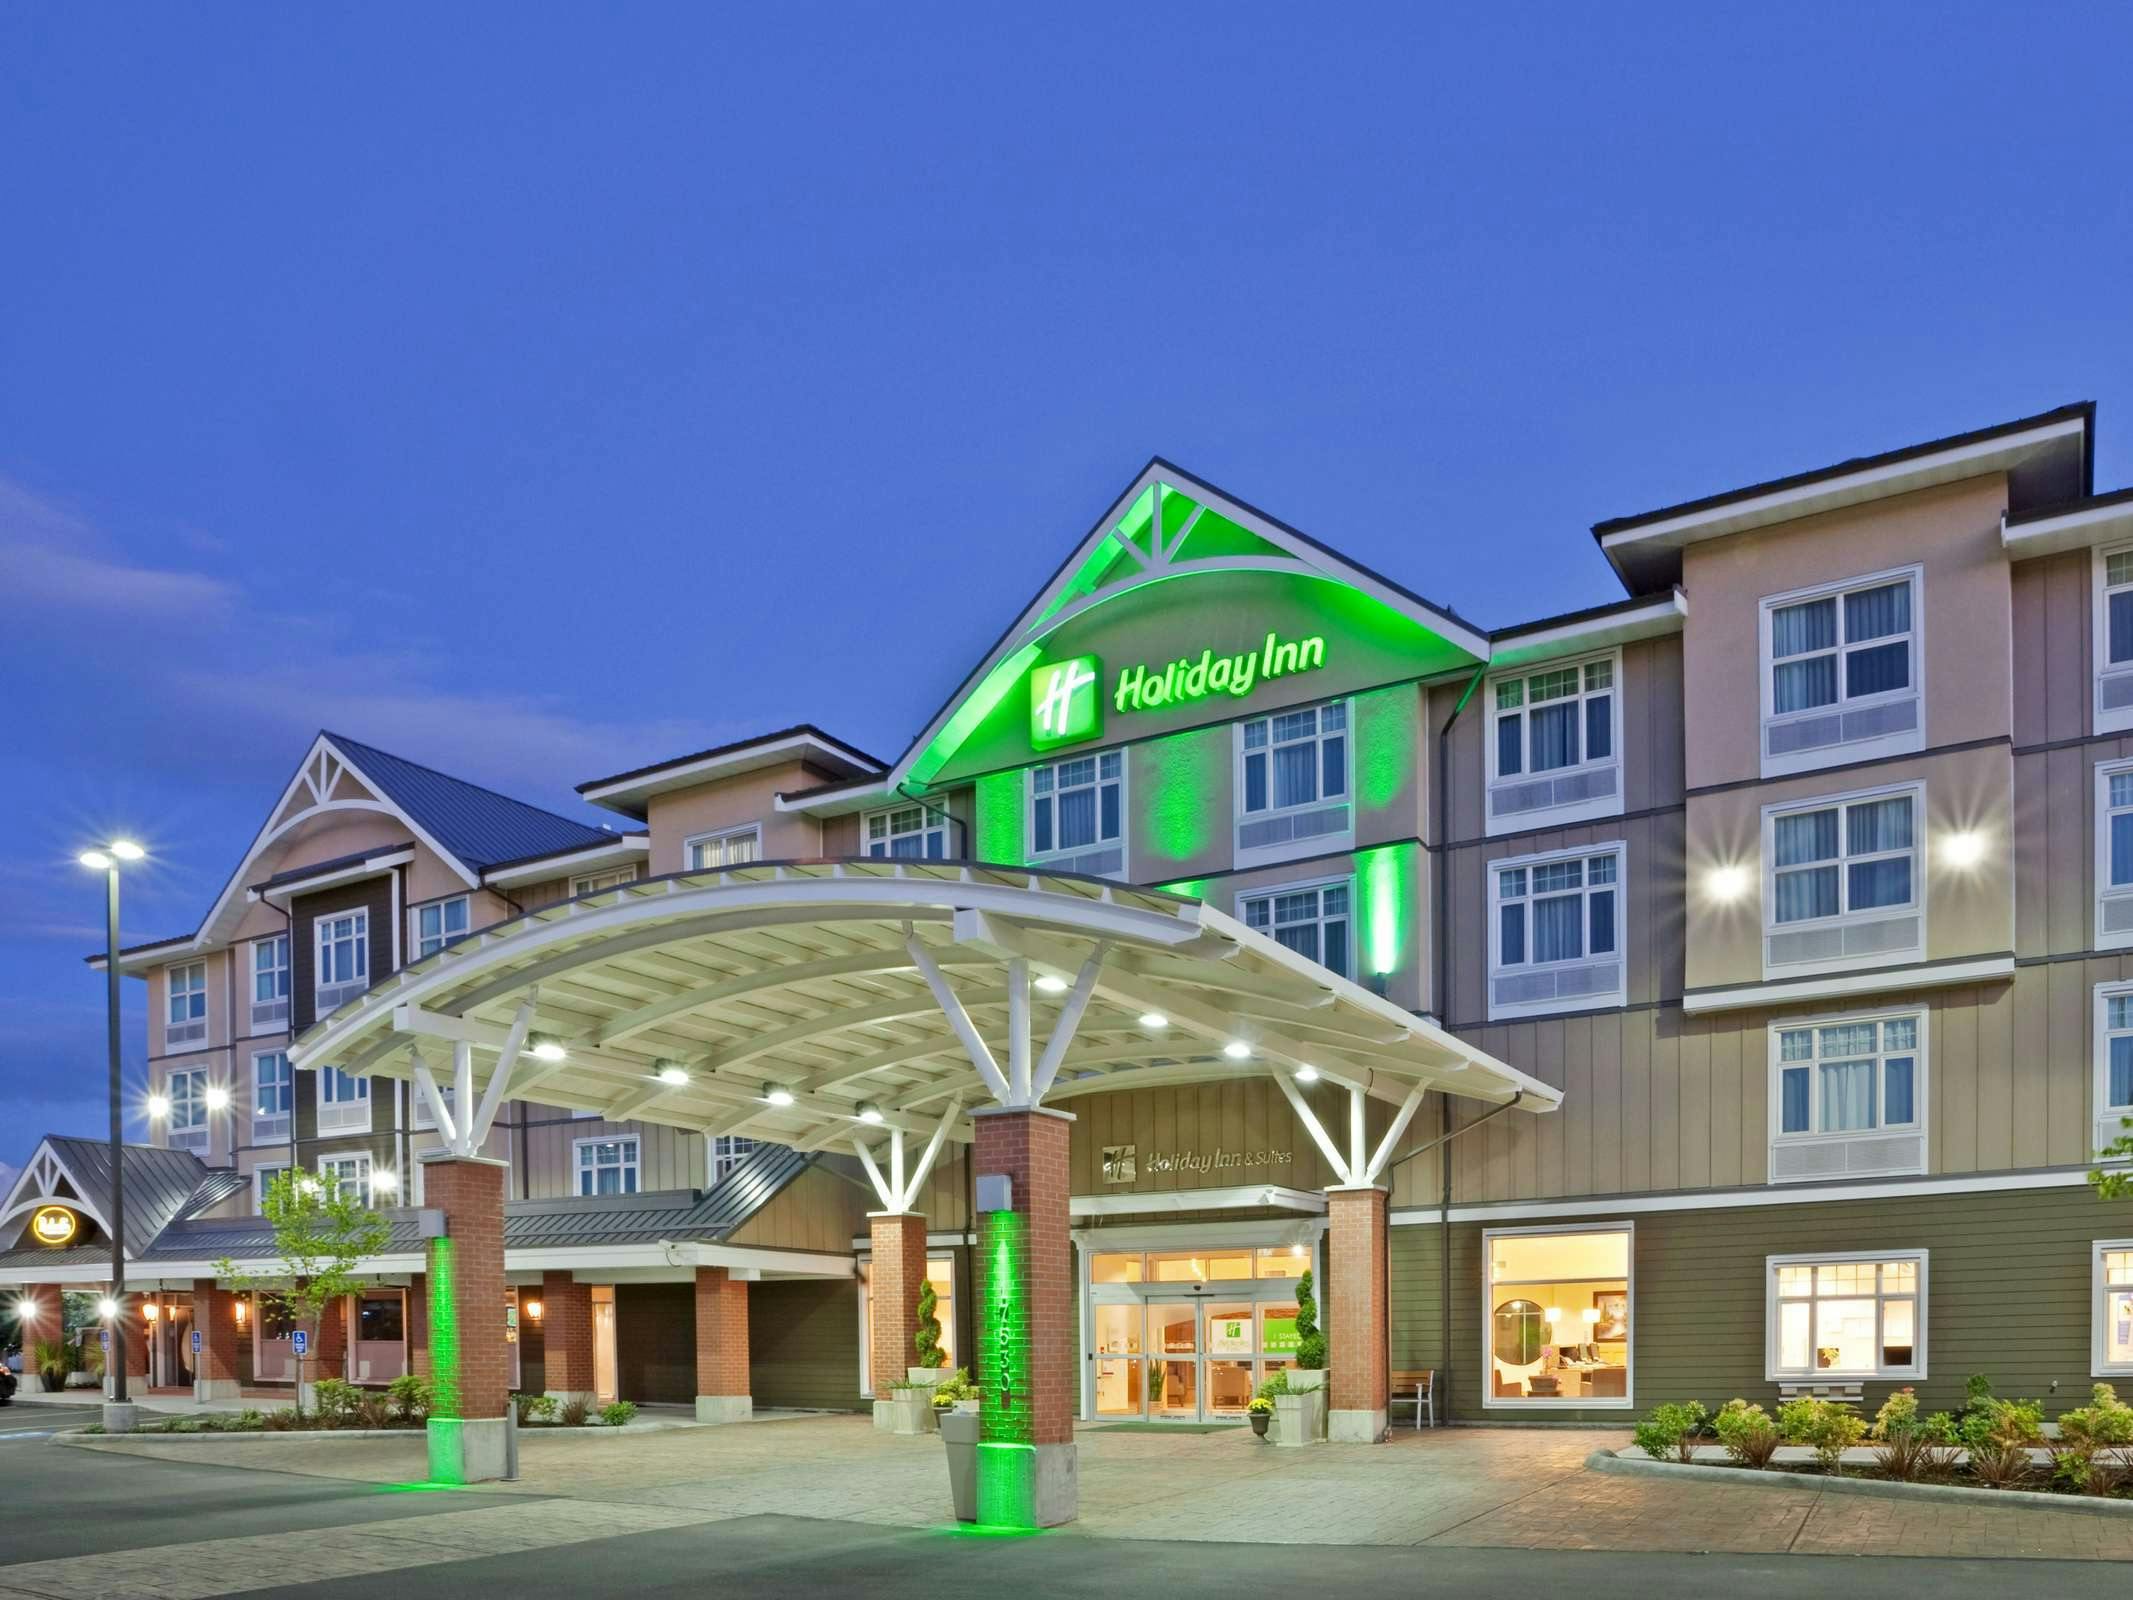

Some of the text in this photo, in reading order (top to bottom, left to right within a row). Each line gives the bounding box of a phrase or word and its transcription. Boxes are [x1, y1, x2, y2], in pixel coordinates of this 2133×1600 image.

[1113, 633, 1325, 713] Holiday Inn
[1146, 1151, 1212, 1174] Holiday
[1215, 1147, 1242, 1168] Inn
[1244, 1152, 1254, 1166] &
